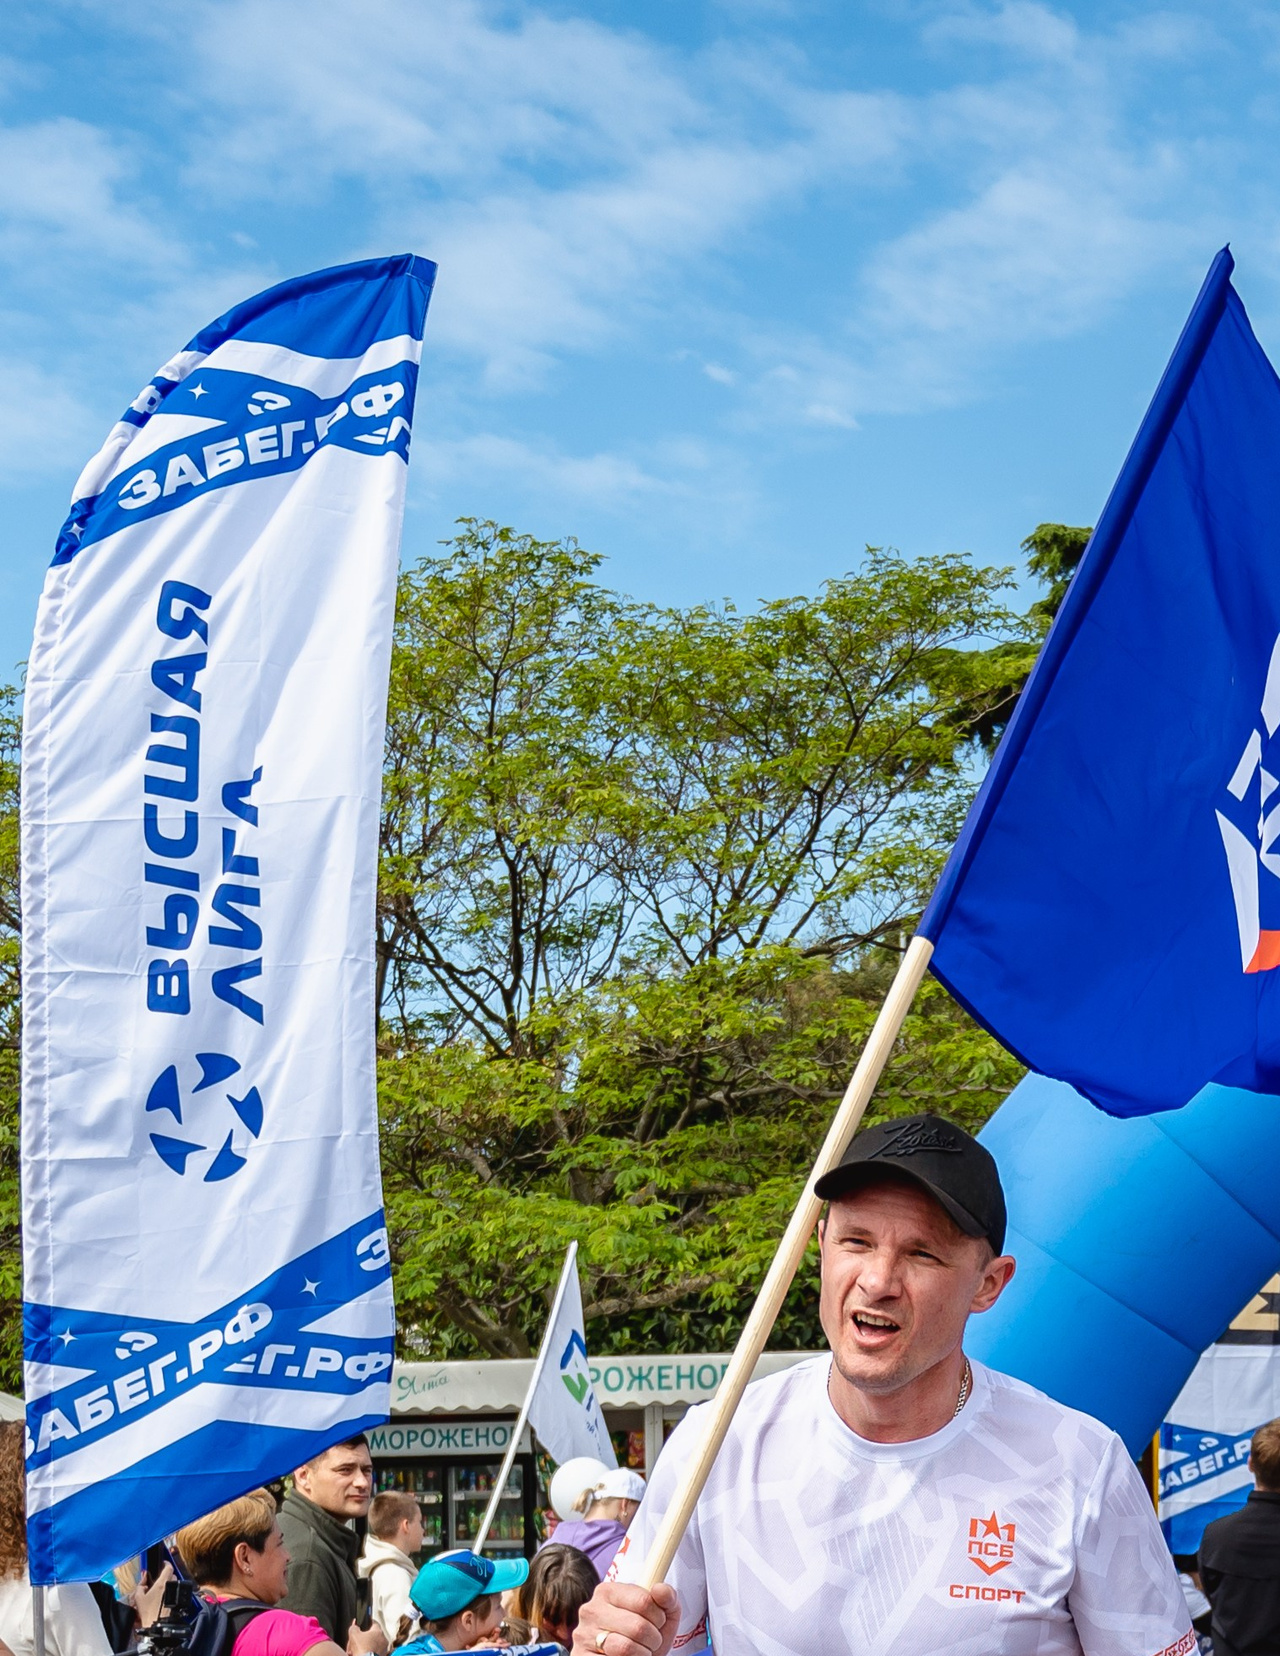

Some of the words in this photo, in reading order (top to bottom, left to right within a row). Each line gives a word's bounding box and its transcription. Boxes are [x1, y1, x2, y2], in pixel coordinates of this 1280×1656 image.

[117, 381, 405, 511] ЗАБЕГ.РФ
[144, 579, 213, 1017] ВЫСШАЯ
[591, 1363, 731, 1393] РОЖЕНО
[967, 1540, 1014, 1558] ПСБ
[949, 1584, 1026, 1604] СПОРТ
